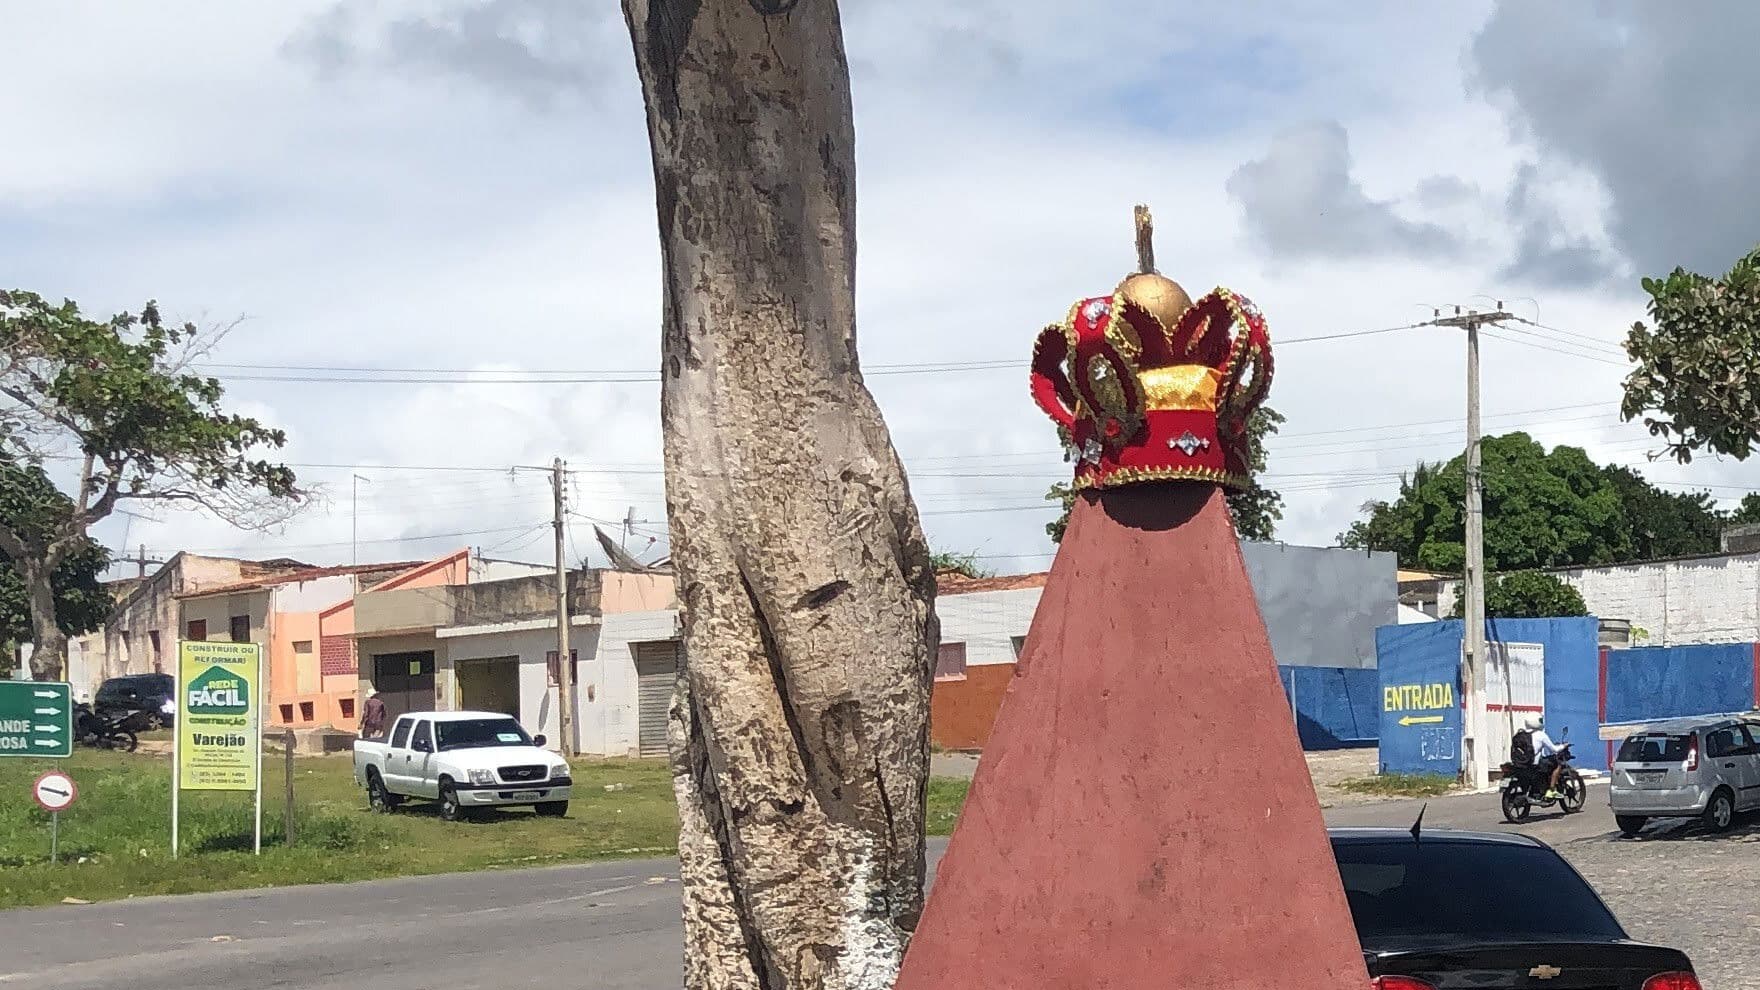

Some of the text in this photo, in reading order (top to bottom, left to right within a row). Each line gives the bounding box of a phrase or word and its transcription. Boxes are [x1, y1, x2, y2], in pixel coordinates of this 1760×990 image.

[208, 680, 239, 689] REDE
[188, 686, 247, 707] FÁCIL
[1384, 683, 1454, 711] ENTRADA
[192, 733, 246, 747] Varejão
